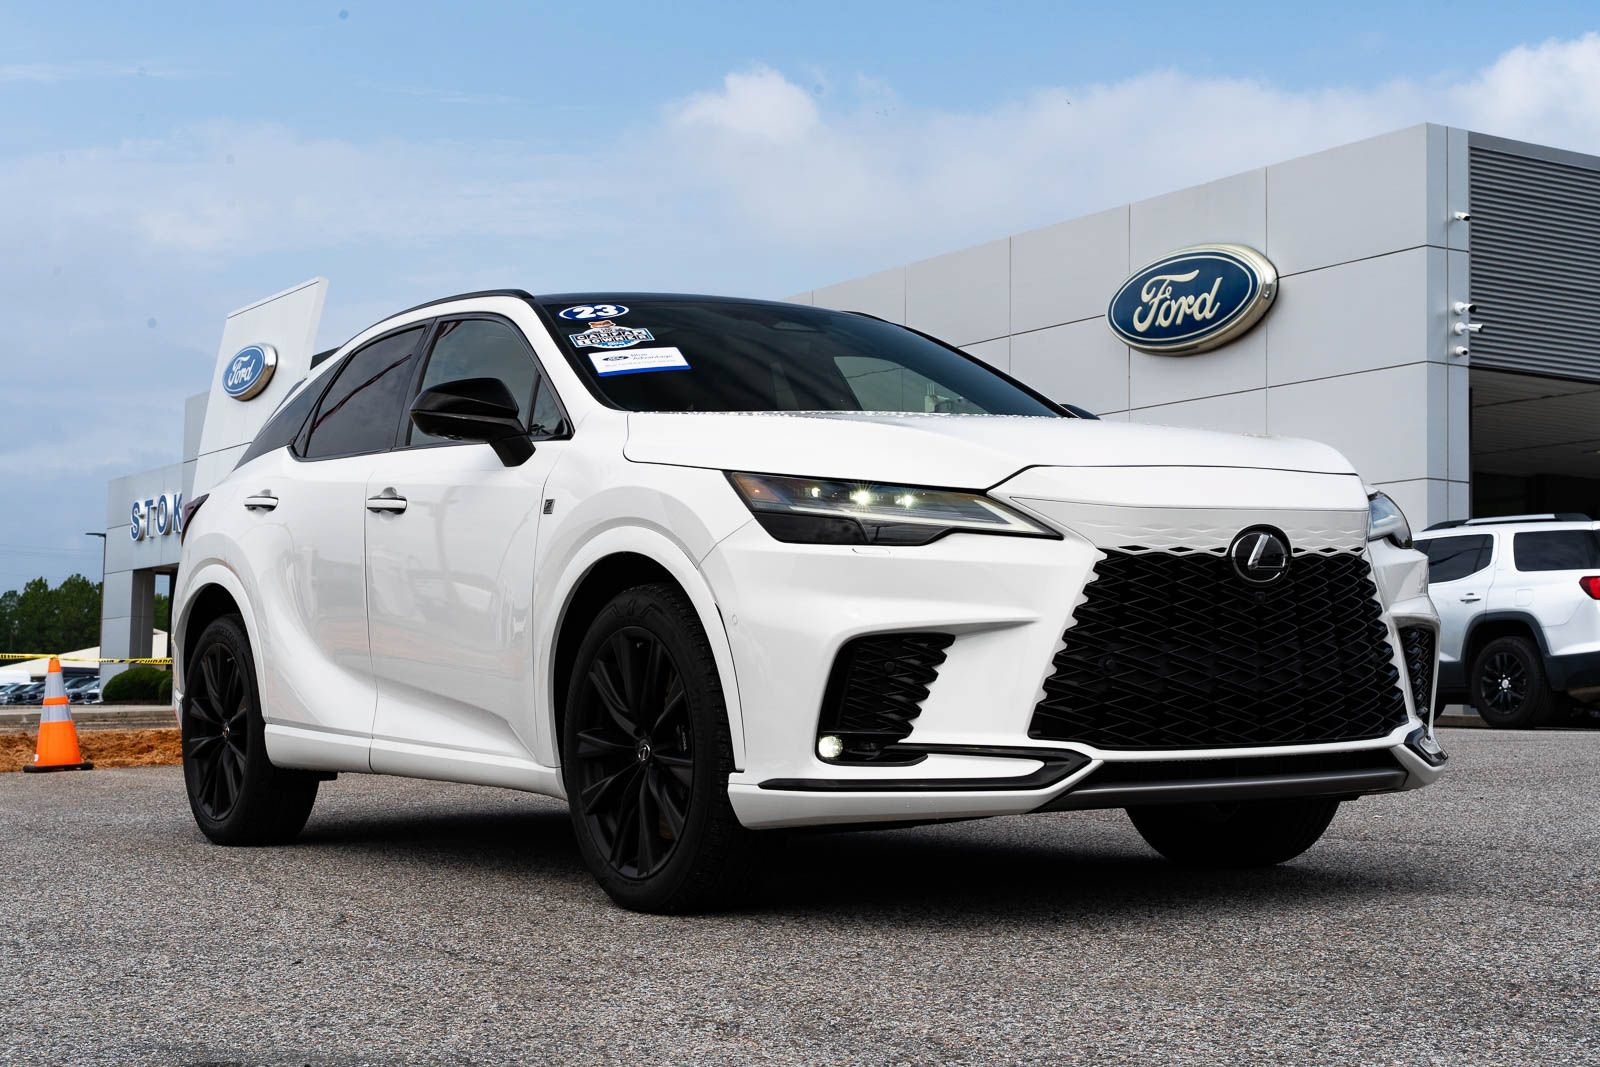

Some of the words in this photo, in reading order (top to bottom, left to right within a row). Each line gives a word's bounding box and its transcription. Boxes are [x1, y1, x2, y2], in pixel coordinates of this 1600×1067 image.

[572, 305, 619, 318] 23
[1133, 269, 1223, 332] Ford
[228, 354, 256, 387] Ford
[130, 492, 182, 541] STOK
